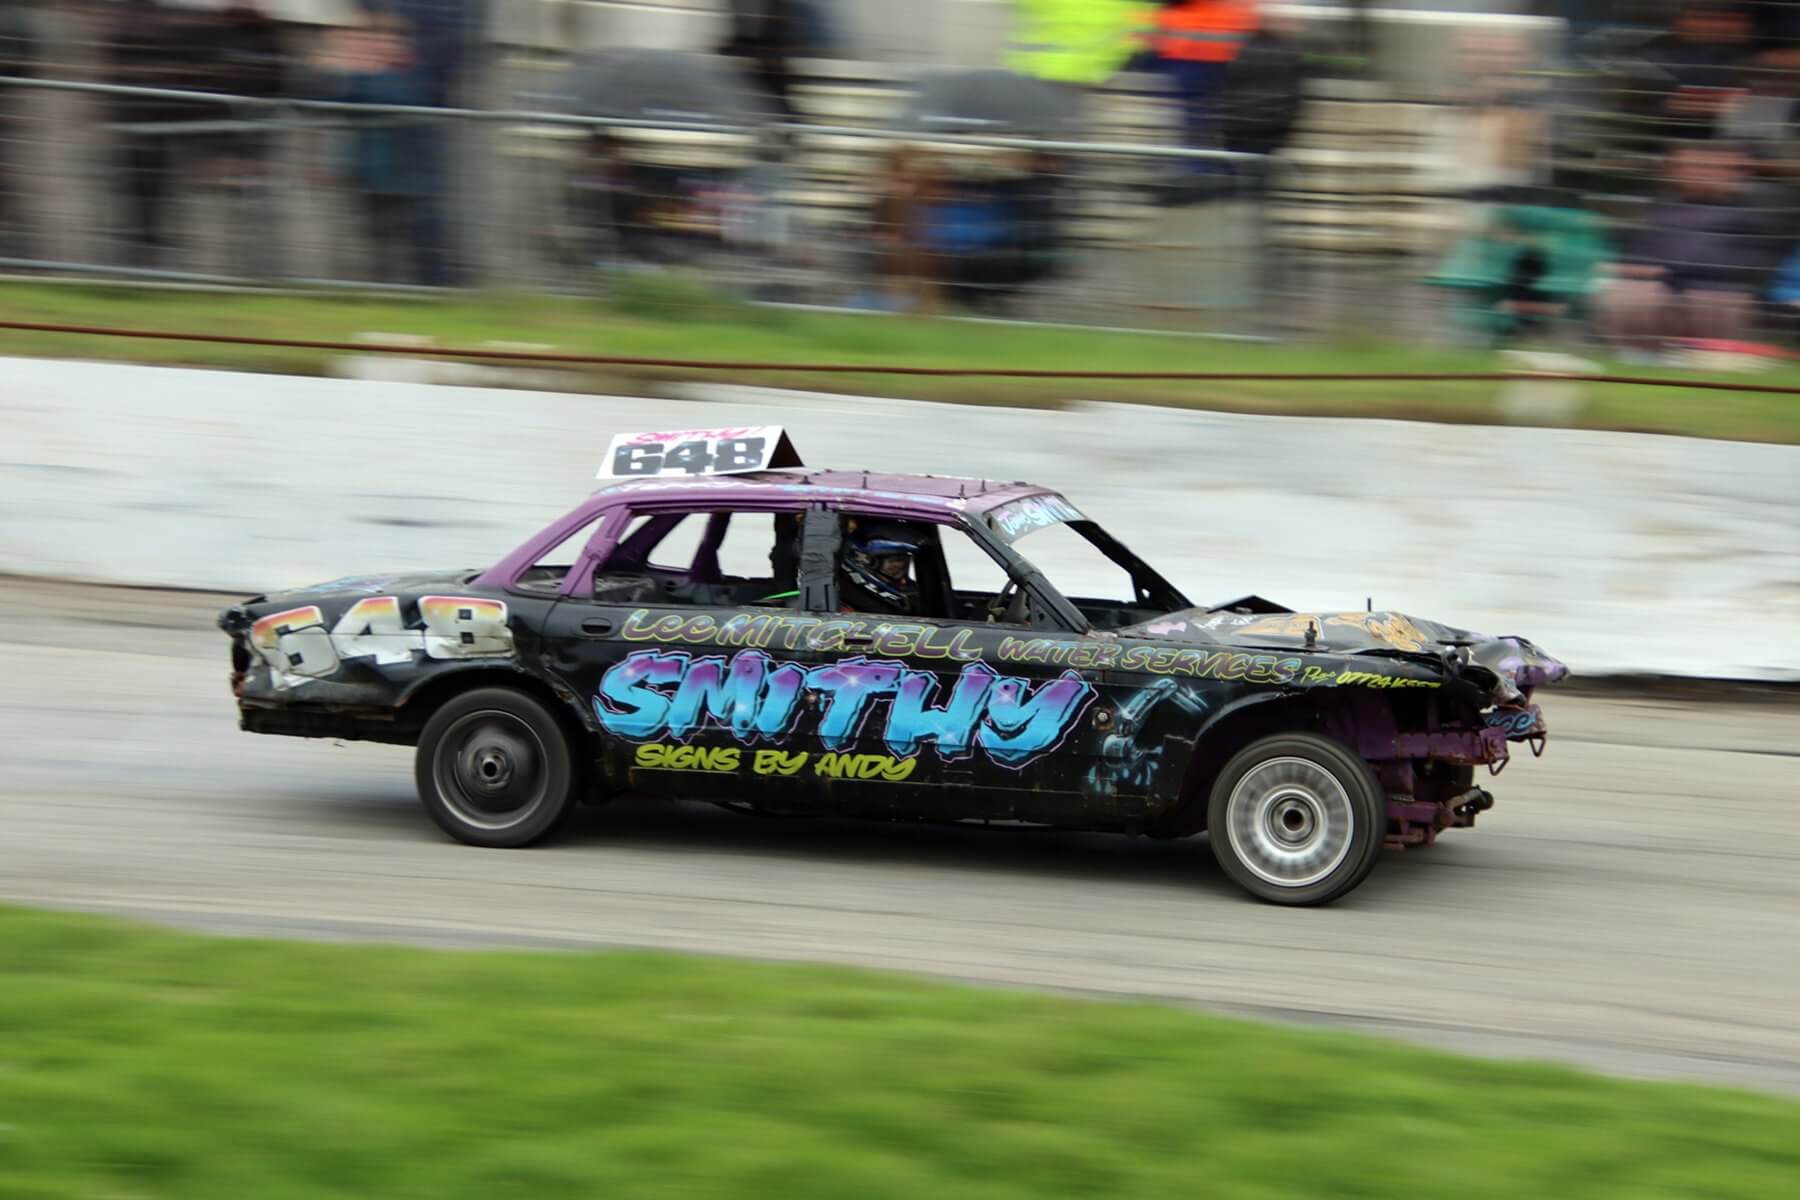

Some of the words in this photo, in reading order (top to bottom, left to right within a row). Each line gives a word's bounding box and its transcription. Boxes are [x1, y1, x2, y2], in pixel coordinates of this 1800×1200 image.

[612, 437, 766, 475] 648
[250, 594, 514, 690] 648
[715, 613, 983, 660] MITCHELL
[997, 636, 1123, 668] WATER
[1120, 646, 1303, 684] SERVICES
[634, 743, 741, 773] SIGNS
[752, 748, 808, 777] BY
[814, 754, 918, 782] ANDY
